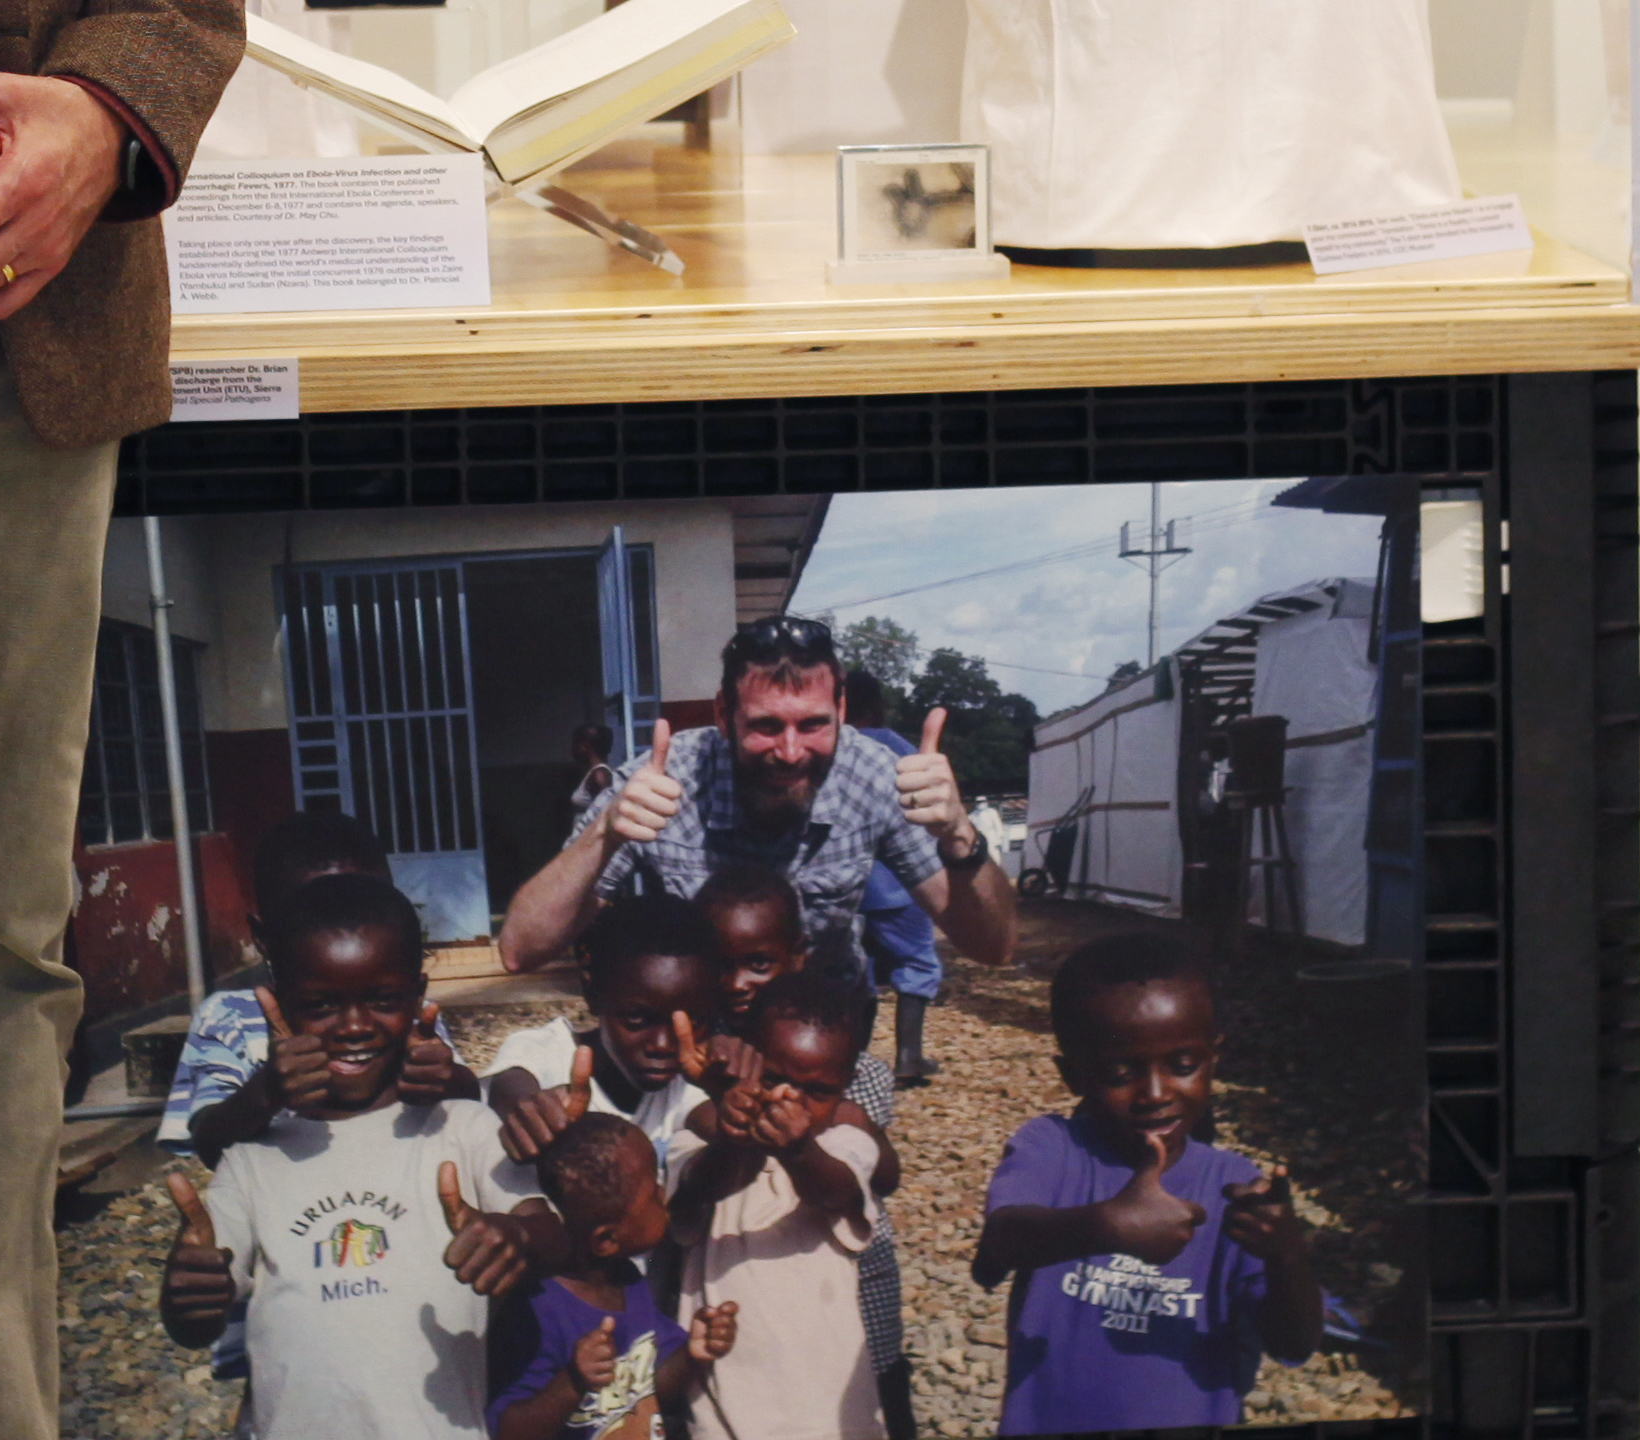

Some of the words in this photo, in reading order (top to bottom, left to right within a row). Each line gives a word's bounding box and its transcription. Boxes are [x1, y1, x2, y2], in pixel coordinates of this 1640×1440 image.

[237, 172, 290, 180] Colloquium
[306, 170, 358, 178] Ebola-Virus
[361, 168, 402, 176] Infection
[182, 183, 235, 191] emorrhagic
[237, 182, 270, 190] Fevers,
[318, 180, 339, 188] book
[341, 179, 379, 187] contains
[381, 178, 395, 186] the
[397, 178, 440, 187] published
[289, 190, 344, 199] International
[373, 189, 424, 197] Conference
[177, 204, 215, 212] Antwerp,
[217, 203, 263, 211] December
[324, 200, 362, 208] contains
[380, 199, 415, 208] agenda,
[417, 198, 459, 207] speakers,
[233, 213, 272, 222] Courtesy
[299, 212, 316, 220] May
[319, 211, 340, 219] Chu.
[179, 282, 226, 291] (Yambuku)
[276, 279, 310, 288] (Nzara).
[313, 278, 331, 286] This
[356, 277, 397, 286] belonged
[409, 276, 420, 284] Dr.
[191, 292, 218, 300] Webb.
[195, 366, 245, 374] researcher
[175, 377, 220, 385] discharge
[225, 385, 252, 394] (ETU),
[290, 1191, 408, 1237] URUAPAN
[321, 1276, 388, 1302] Mich.
[1101, 1310, 1149, 1334] 2011
